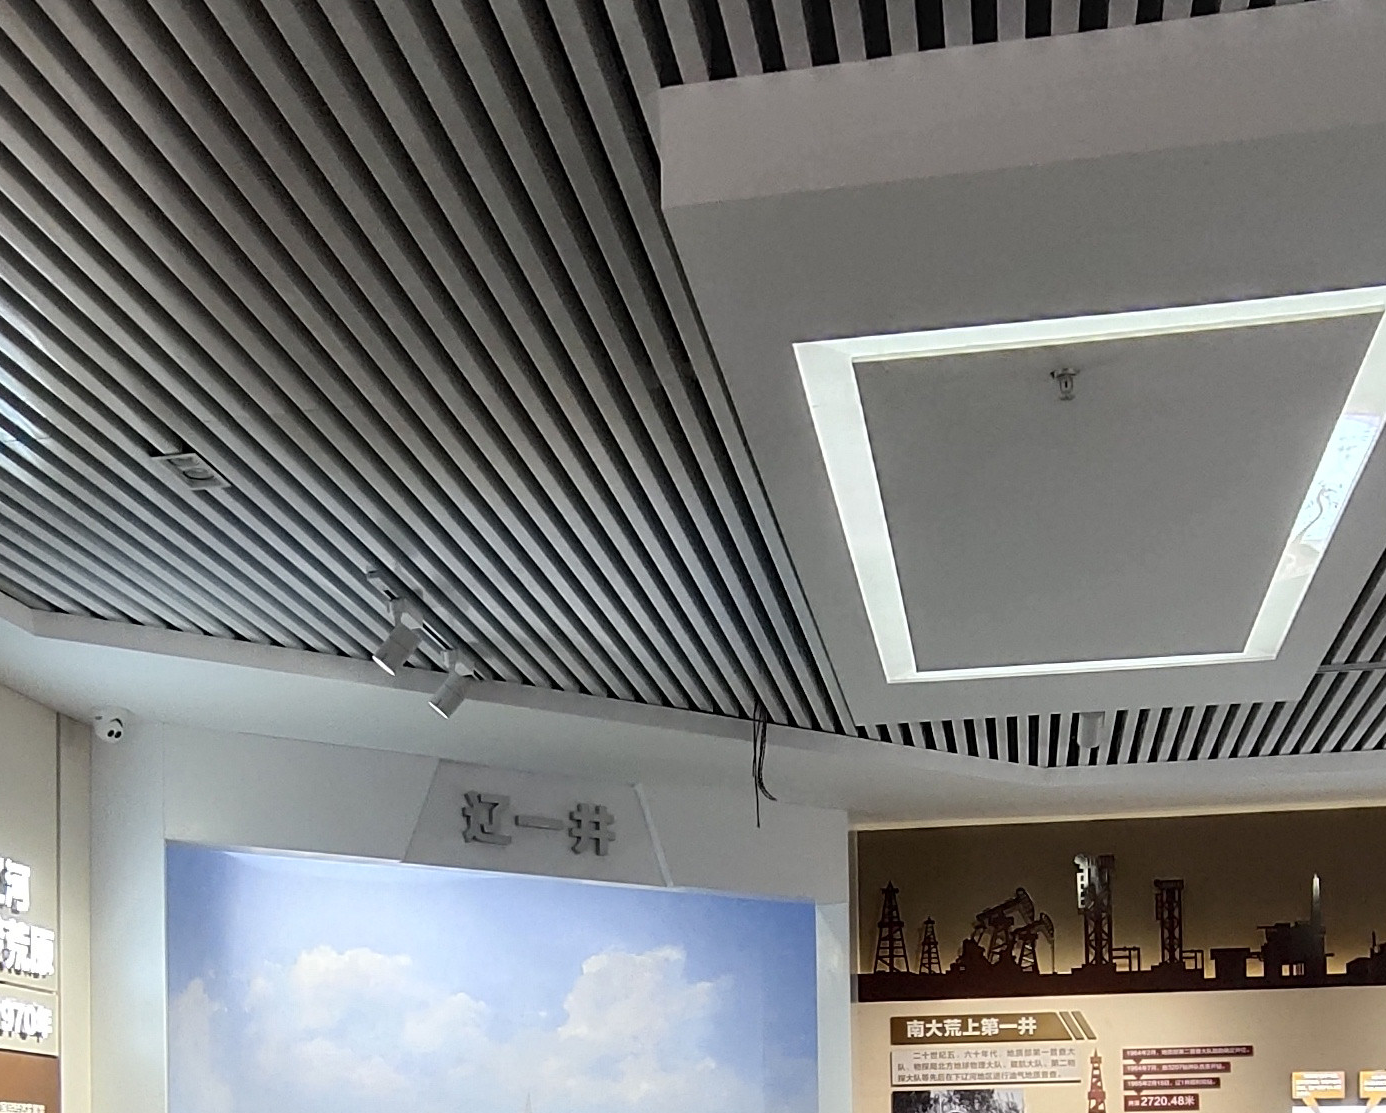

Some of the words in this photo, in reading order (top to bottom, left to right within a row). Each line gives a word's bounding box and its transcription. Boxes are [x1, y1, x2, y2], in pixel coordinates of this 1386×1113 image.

[461, 790, 616, 856] 辽一井
[906, 1016, 1037, 1038] 南大荒上第一井
